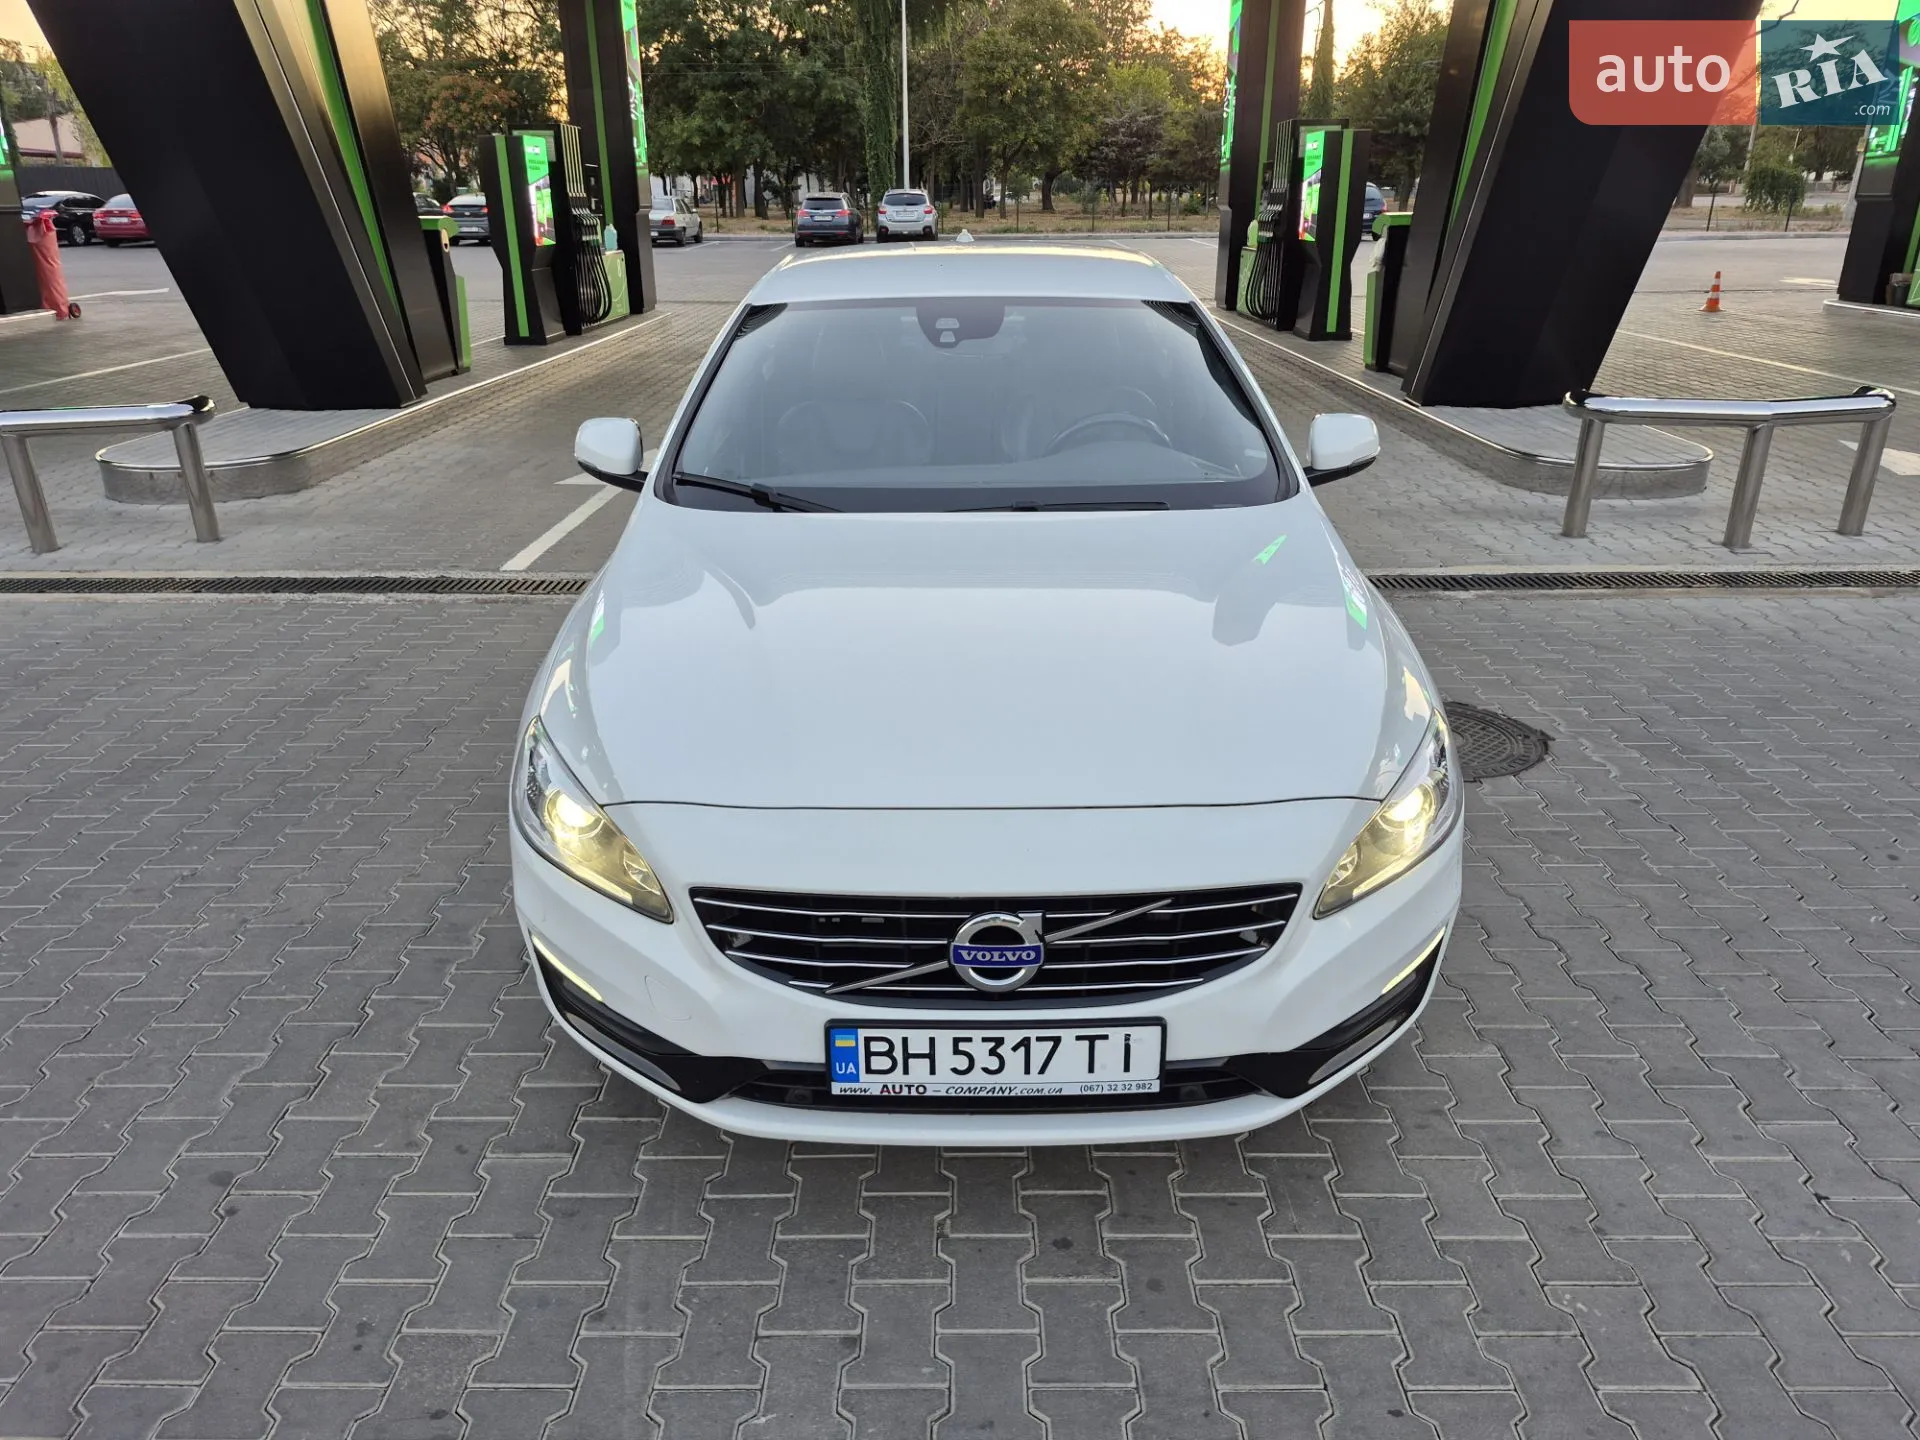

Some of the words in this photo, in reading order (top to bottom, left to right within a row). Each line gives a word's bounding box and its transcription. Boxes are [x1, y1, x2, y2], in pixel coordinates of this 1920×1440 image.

[958, 949, 1036, 962] VOLVO
[863, 1035, 936, 1076] BH
[949, 1035, 1062, 1076] 5317
[835, 1062, 857, 1075] UA
[880, 1084, 927, 1095] AUTO
[1079, 1084, 1104, 1094] (067)
[1107, 1083, 1119, 1092] 32
[1121, 1082, 1133, 1091] 32
[1135, 1082, 1153, 1091] 982
